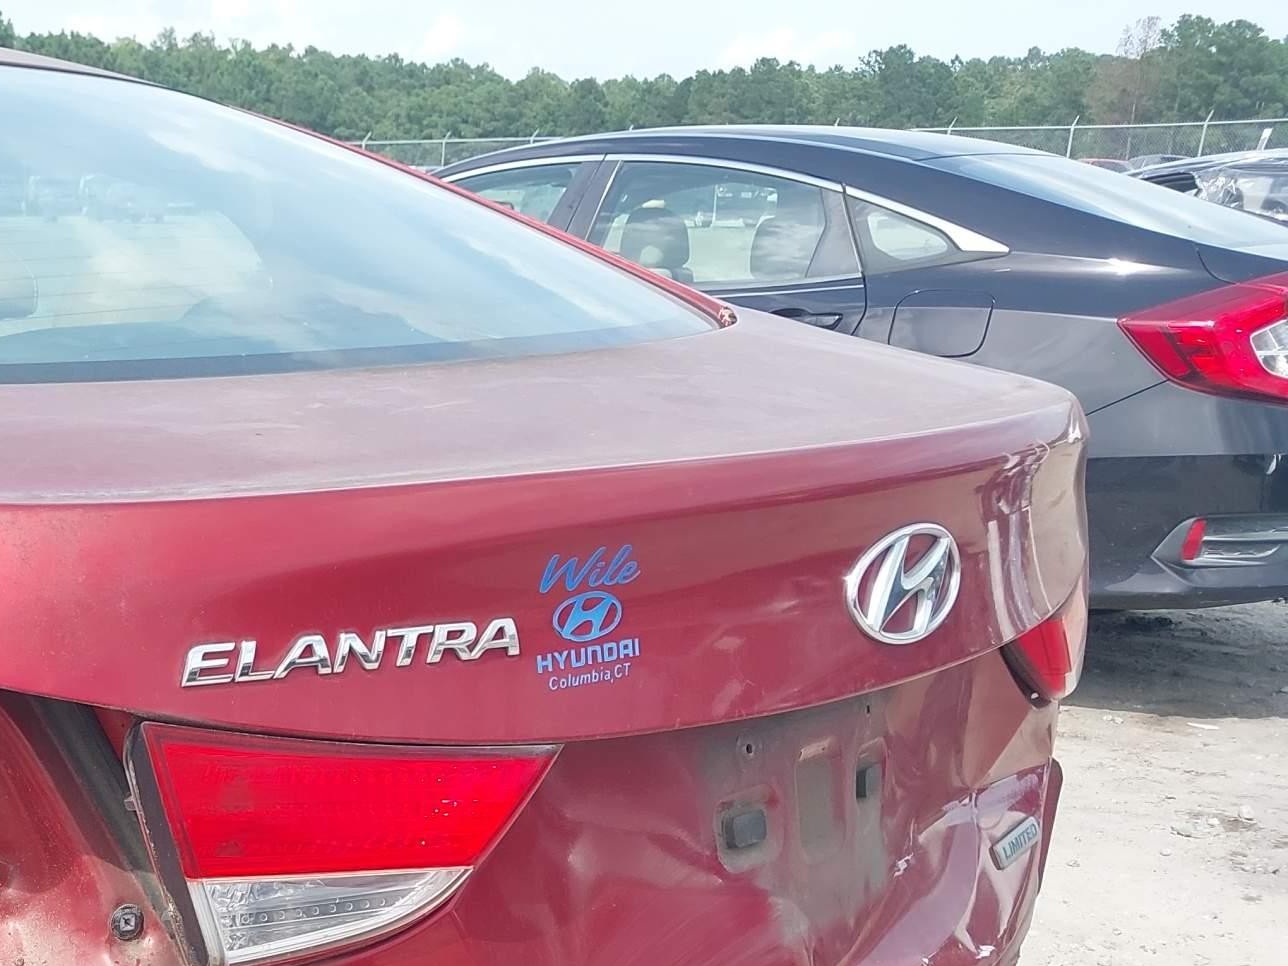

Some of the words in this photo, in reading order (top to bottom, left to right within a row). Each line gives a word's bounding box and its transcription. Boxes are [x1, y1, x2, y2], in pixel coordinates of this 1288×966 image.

[539, 544, 641, 594] Wile
[181, 618, 520, 687] ELANTRA
[537, 638, 640, 674] HYUNDAI
[1002, 824, 1038, 860] LIMITED
